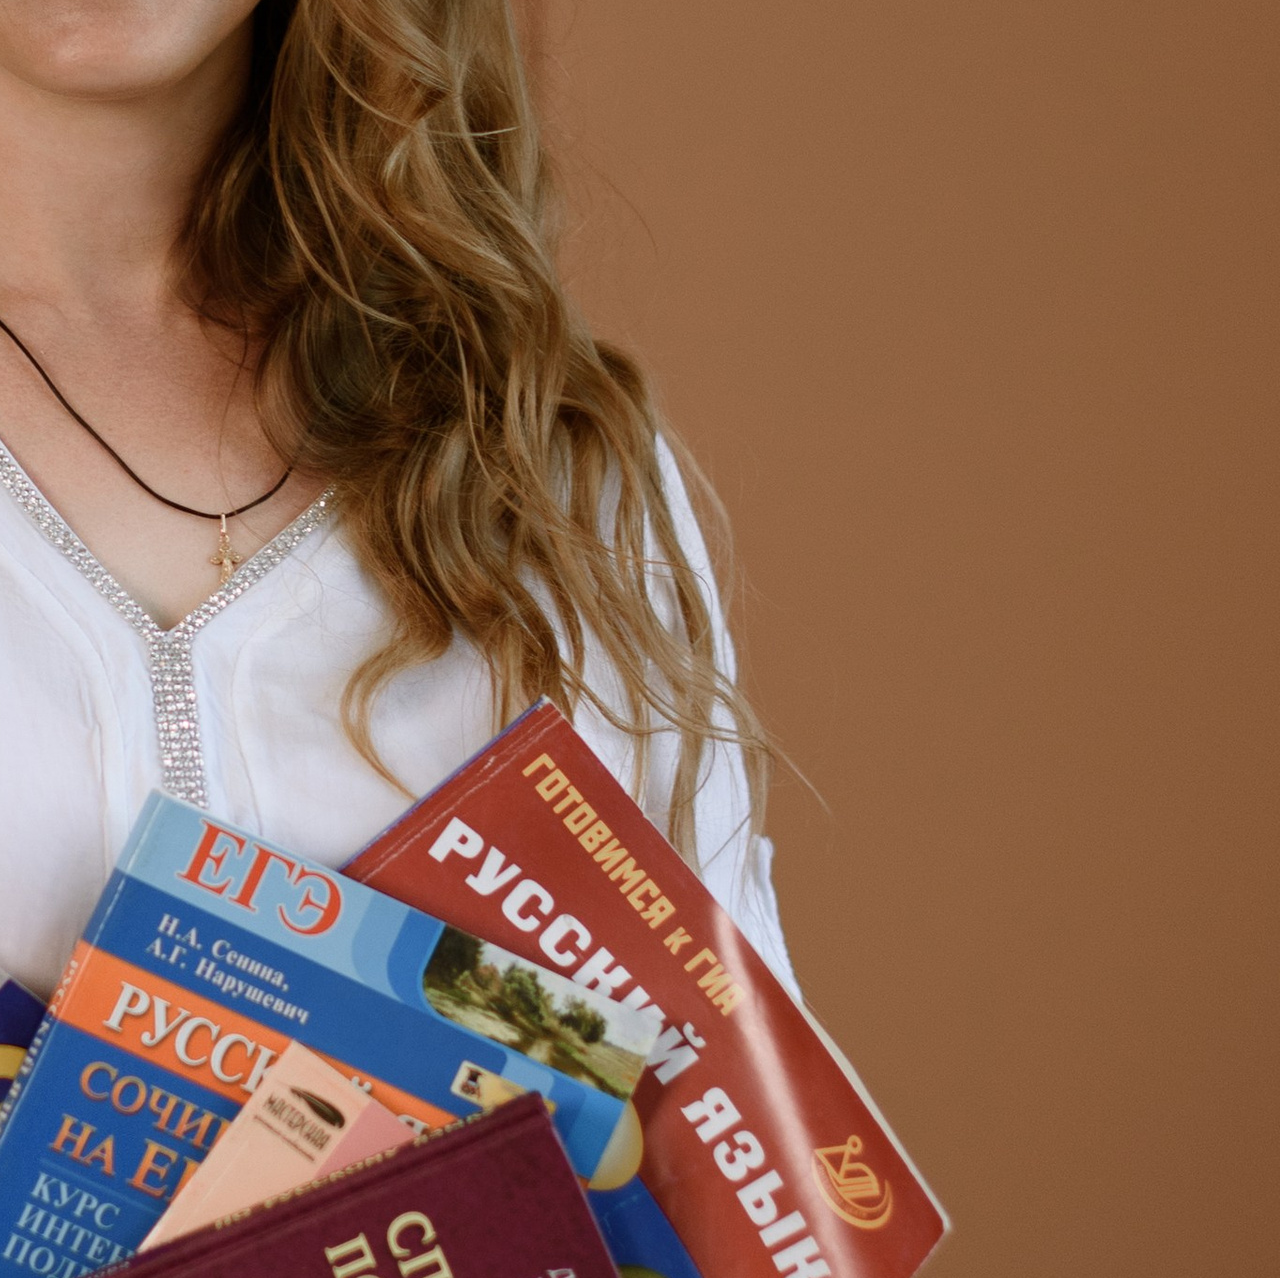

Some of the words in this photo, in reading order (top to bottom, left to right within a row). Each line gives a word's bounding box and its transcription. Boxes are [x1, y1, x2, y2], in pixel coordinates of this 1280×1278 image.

[176, 819, 343, 937] ЕГЭ
[522, 753, 676, 929] ГОТОВИМСЯ
[684, 947, 746, 1016] ГИА
[146, 937, 187, 969] А.Г.
[195, 957, 309, 1026] Нарушевич
[157, 913, 202, 950] Н.А.
[211, 939, 289, 992] Сенина,
[428, 816, 706, 1085] РУССКИЙ
[49, 1113, 117, 1177] НА
[30, 1171, 120, 1230] КУРС
